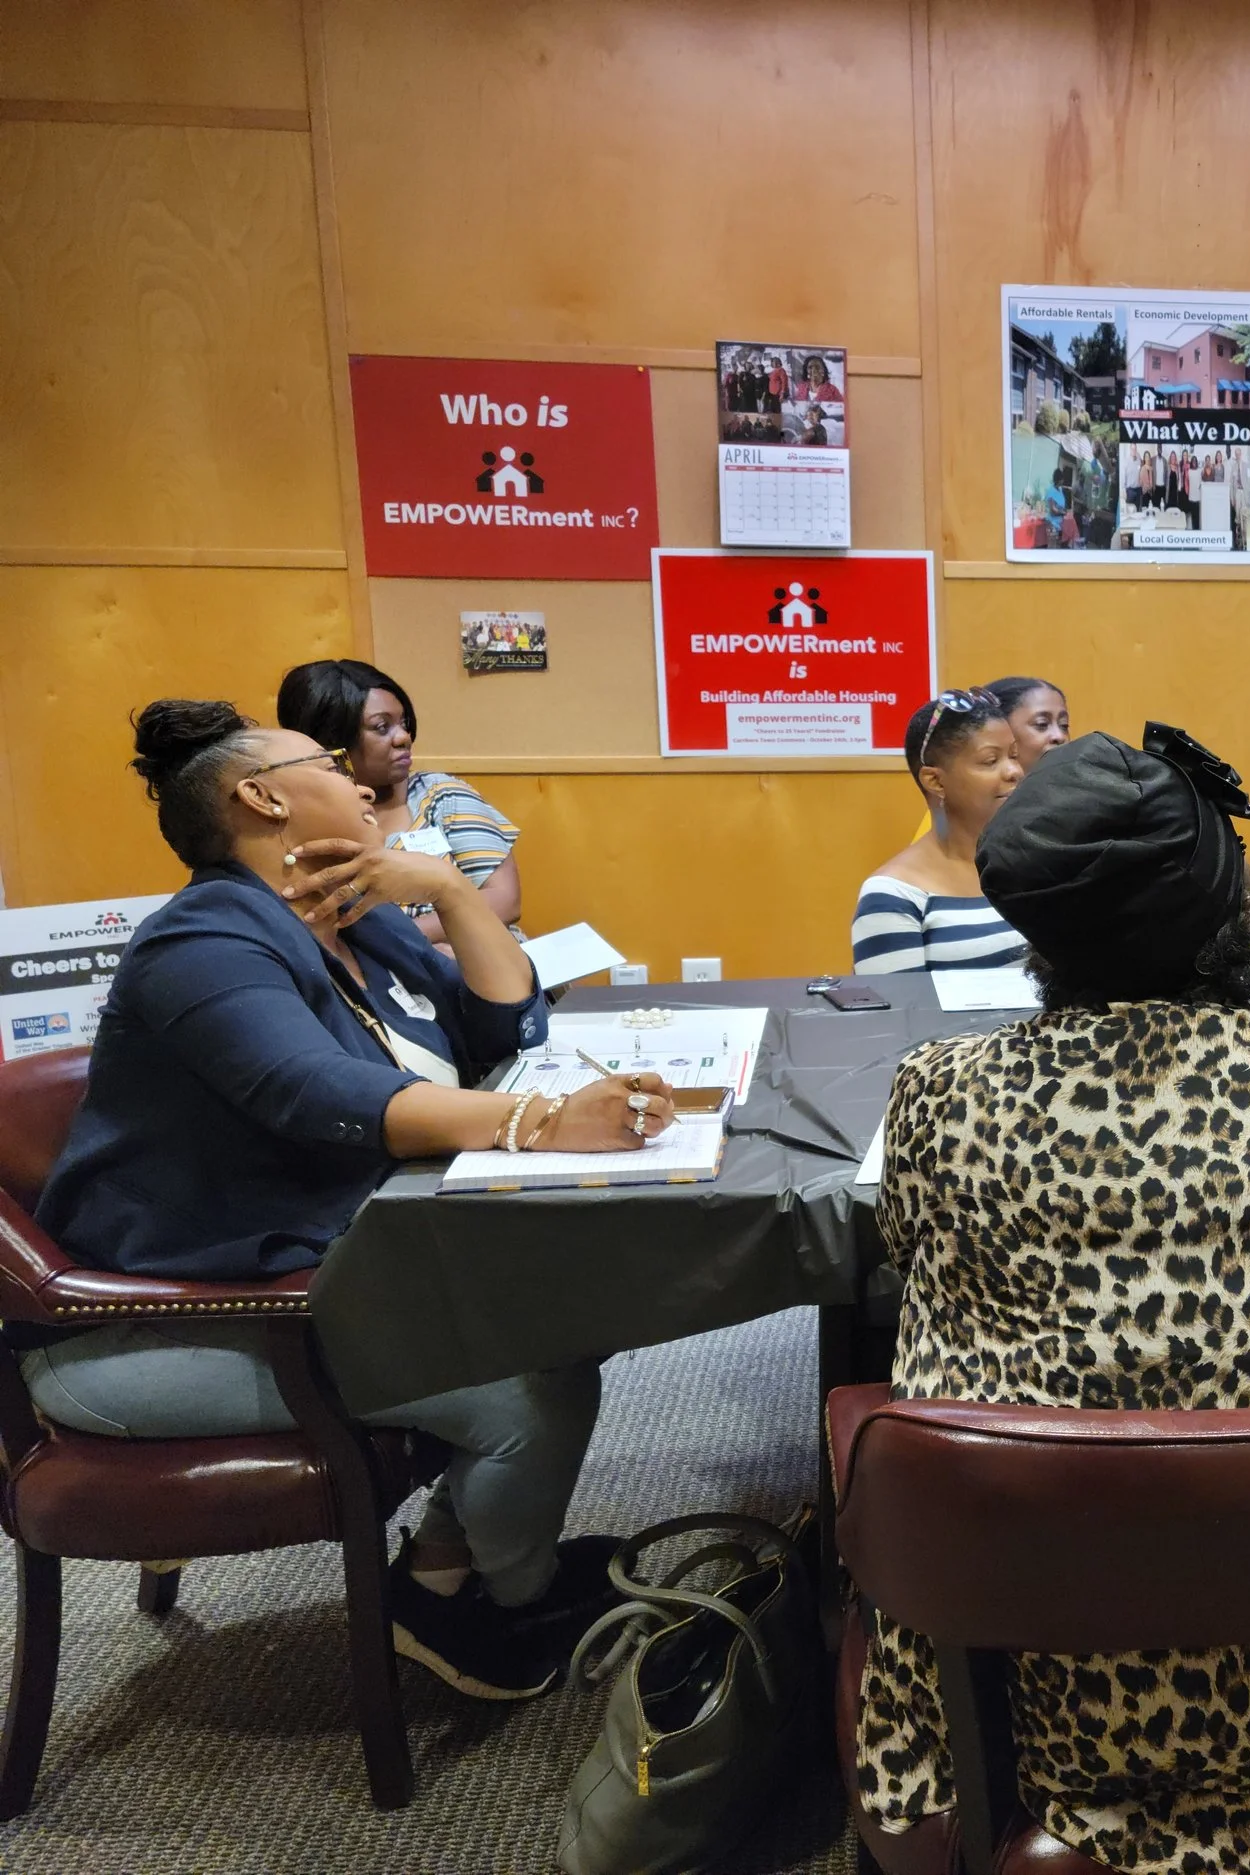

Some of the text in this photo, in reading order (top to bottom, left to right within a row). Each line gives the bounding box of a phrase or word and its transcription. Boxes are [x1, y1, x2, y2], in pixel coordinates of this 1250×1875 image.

[1020, 306, 1113, 320] Affordable Rentals
[1134, 309, 1249, 324] Economic Development
[440, 394, 569, 428] Who is
[1123, 420, 1179, 440] What
[1184, 421, 1218, 441] We
[724, 448, 764, 464] APRIL
[383, 503, 594, 528] EMPOWERment
[1139, 535, 1226, 545] Local Government
[690, 634, 904, 653] EMPOWERment INC
[500, 654, 544, 664] THANKS
[789, 661, 807, 679] is
[700, 690, 897, 705] Building Affordable Housing
[738, 713, 861, 726] empowermentinc.org
[49, 925, 138, 941] EMPOWER
[11, 952, 120, 978] Cheers to
[91, 973, 115, 984] Spo
[13, 1018, 45, 1029] United
[27, 1026, 46, 1036] Way
